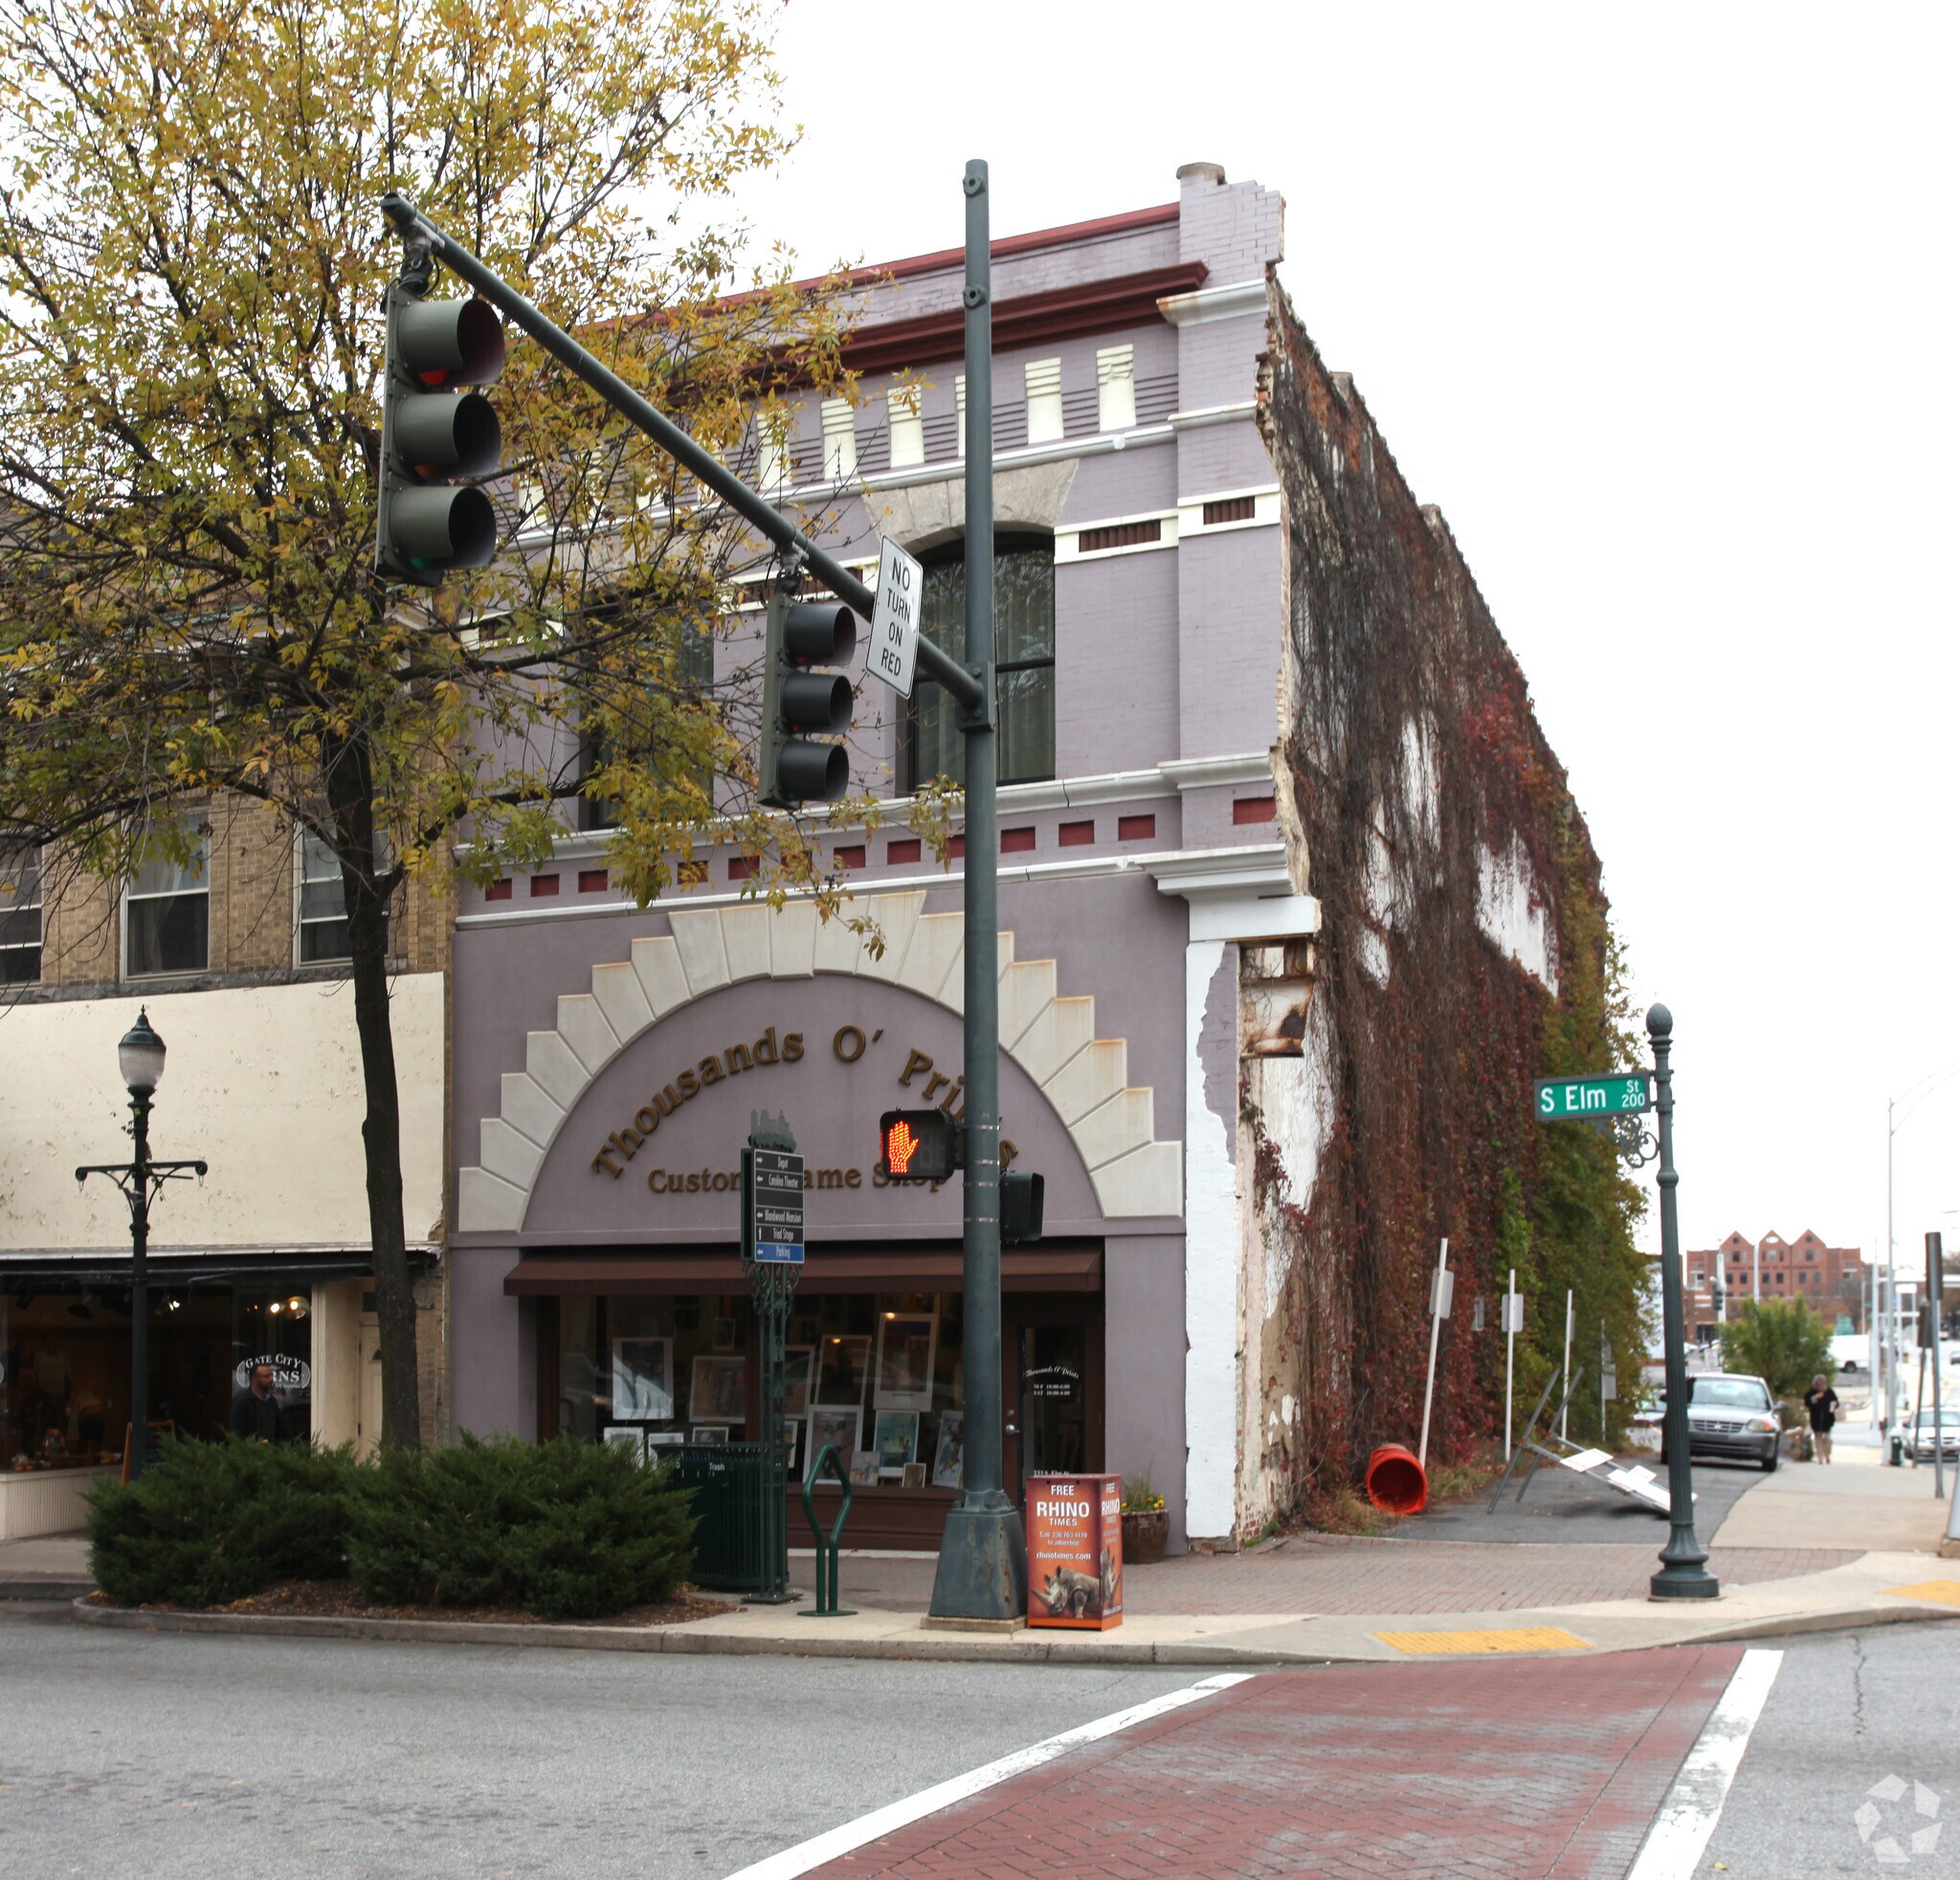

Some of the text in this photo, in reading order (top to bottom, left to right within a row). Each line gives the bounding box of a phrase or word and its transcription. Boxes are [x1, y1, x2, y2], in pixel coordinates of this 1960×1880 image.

[891, 556, 910, 592] NO
[886, 588, 911, 624] TURN
[888, 621, 903, 647] ON
[880, 647, 902, 677] RED
[1626, 1080, 1639, 1093] St
[591, 1026, 805, 1180] Thousands
[898, 1047, 1019, 1167] Pris
[1540, 1085, 1645, 1112] S Elm 200
[804, 1169, 862, 1189] ame
[775, 1244, 791, 1260] Parking
[1051, 1485, 1075, 1496] FREE
[1036, 1501, 1090, 1518] RHINO
[1101, 1497, 1120, 1517] RHINO
[1049, 1517, 1078, 1527] TIMES
[1036, 1551, 1091, 1560] rhinotimes.com
